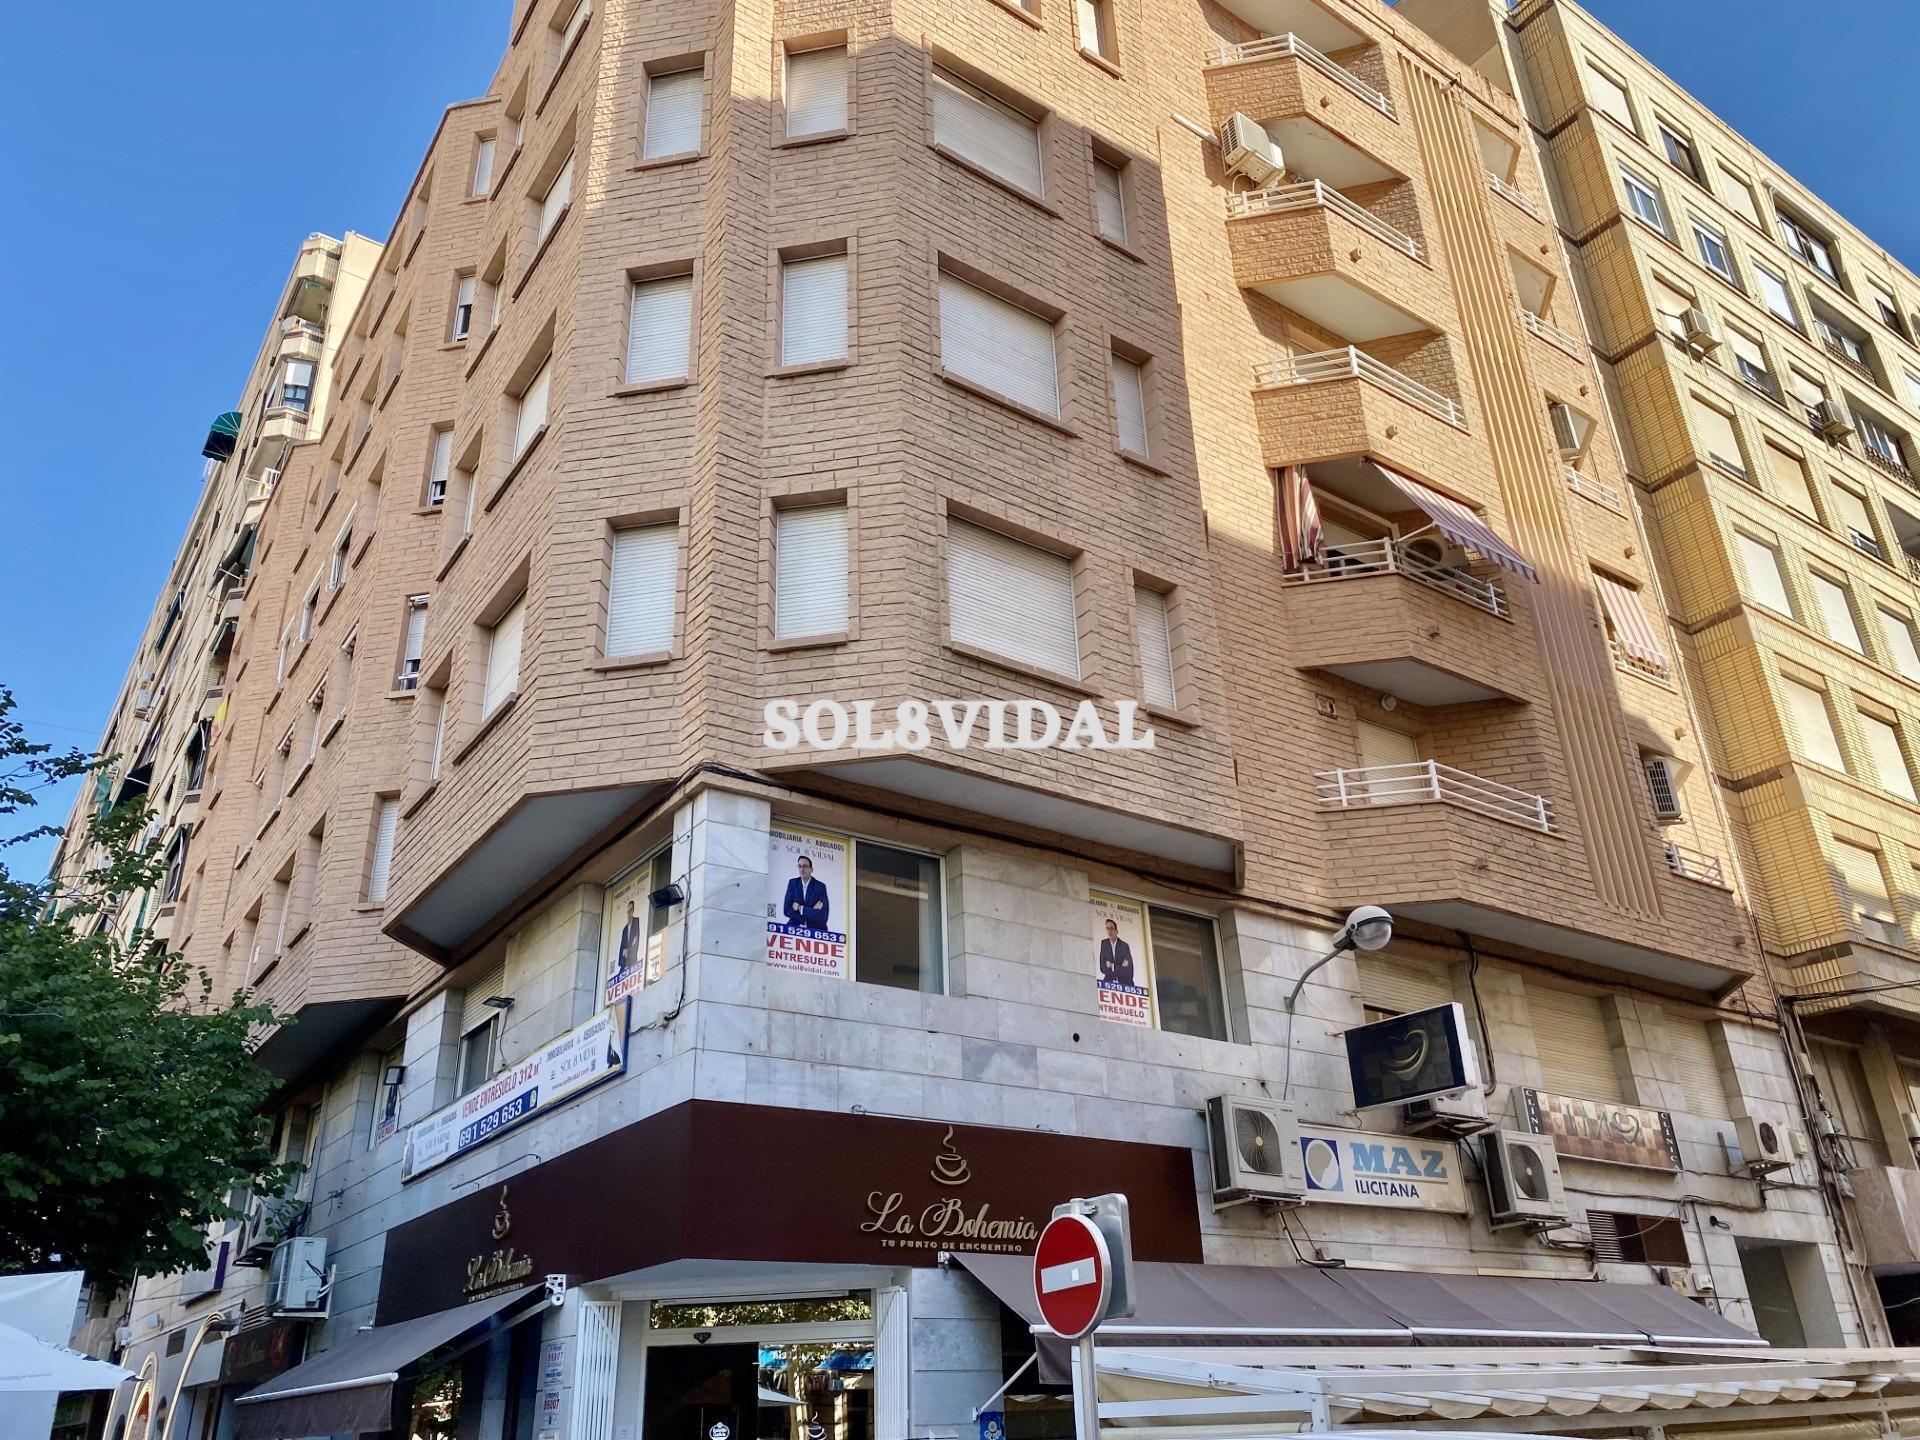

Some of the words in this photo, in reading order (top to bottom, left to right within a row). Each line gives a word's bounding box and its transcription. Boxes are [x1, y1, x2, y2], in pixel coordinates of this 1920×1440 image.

[766, 934, 845, 959] VENDE
[787, 926, 812, 938] 529
[815, 932, 837, 943] 653
[768, 950, 837, 968] ENTRESUELO
[607, 971, 645, 1002] VENDE
[1105, 982, 1123, 992] 529
[1124, 986, 1143, 996] 653
[1099, 989, 1149, 1010] ENDE
[479, 1071, 518, 1109] ENTRESUELO
[518, 1062, 533, 1086] 312
[459, 1123, 478, 1147] 691
[479, 1111, 500, 1136] 529
[501, 1098, 523, 1124] 653
[1660, 1112, 1682, 1172] CLINICA
[1350, 1142, 1449, 1179] MAZ
[1354, 1179, 1421, 1199] ILICITANA
[860, 1191, 914, 1234] La
[919, 1198, 1039, 1241] Bohemia
[881, 1239, 895, 1248] TU
[900, 1239, 938, 1249] PUNTO
[942, 1241, 955, 1250] DE
[959, 1241, 1022, 1252] ENCUENTRO
